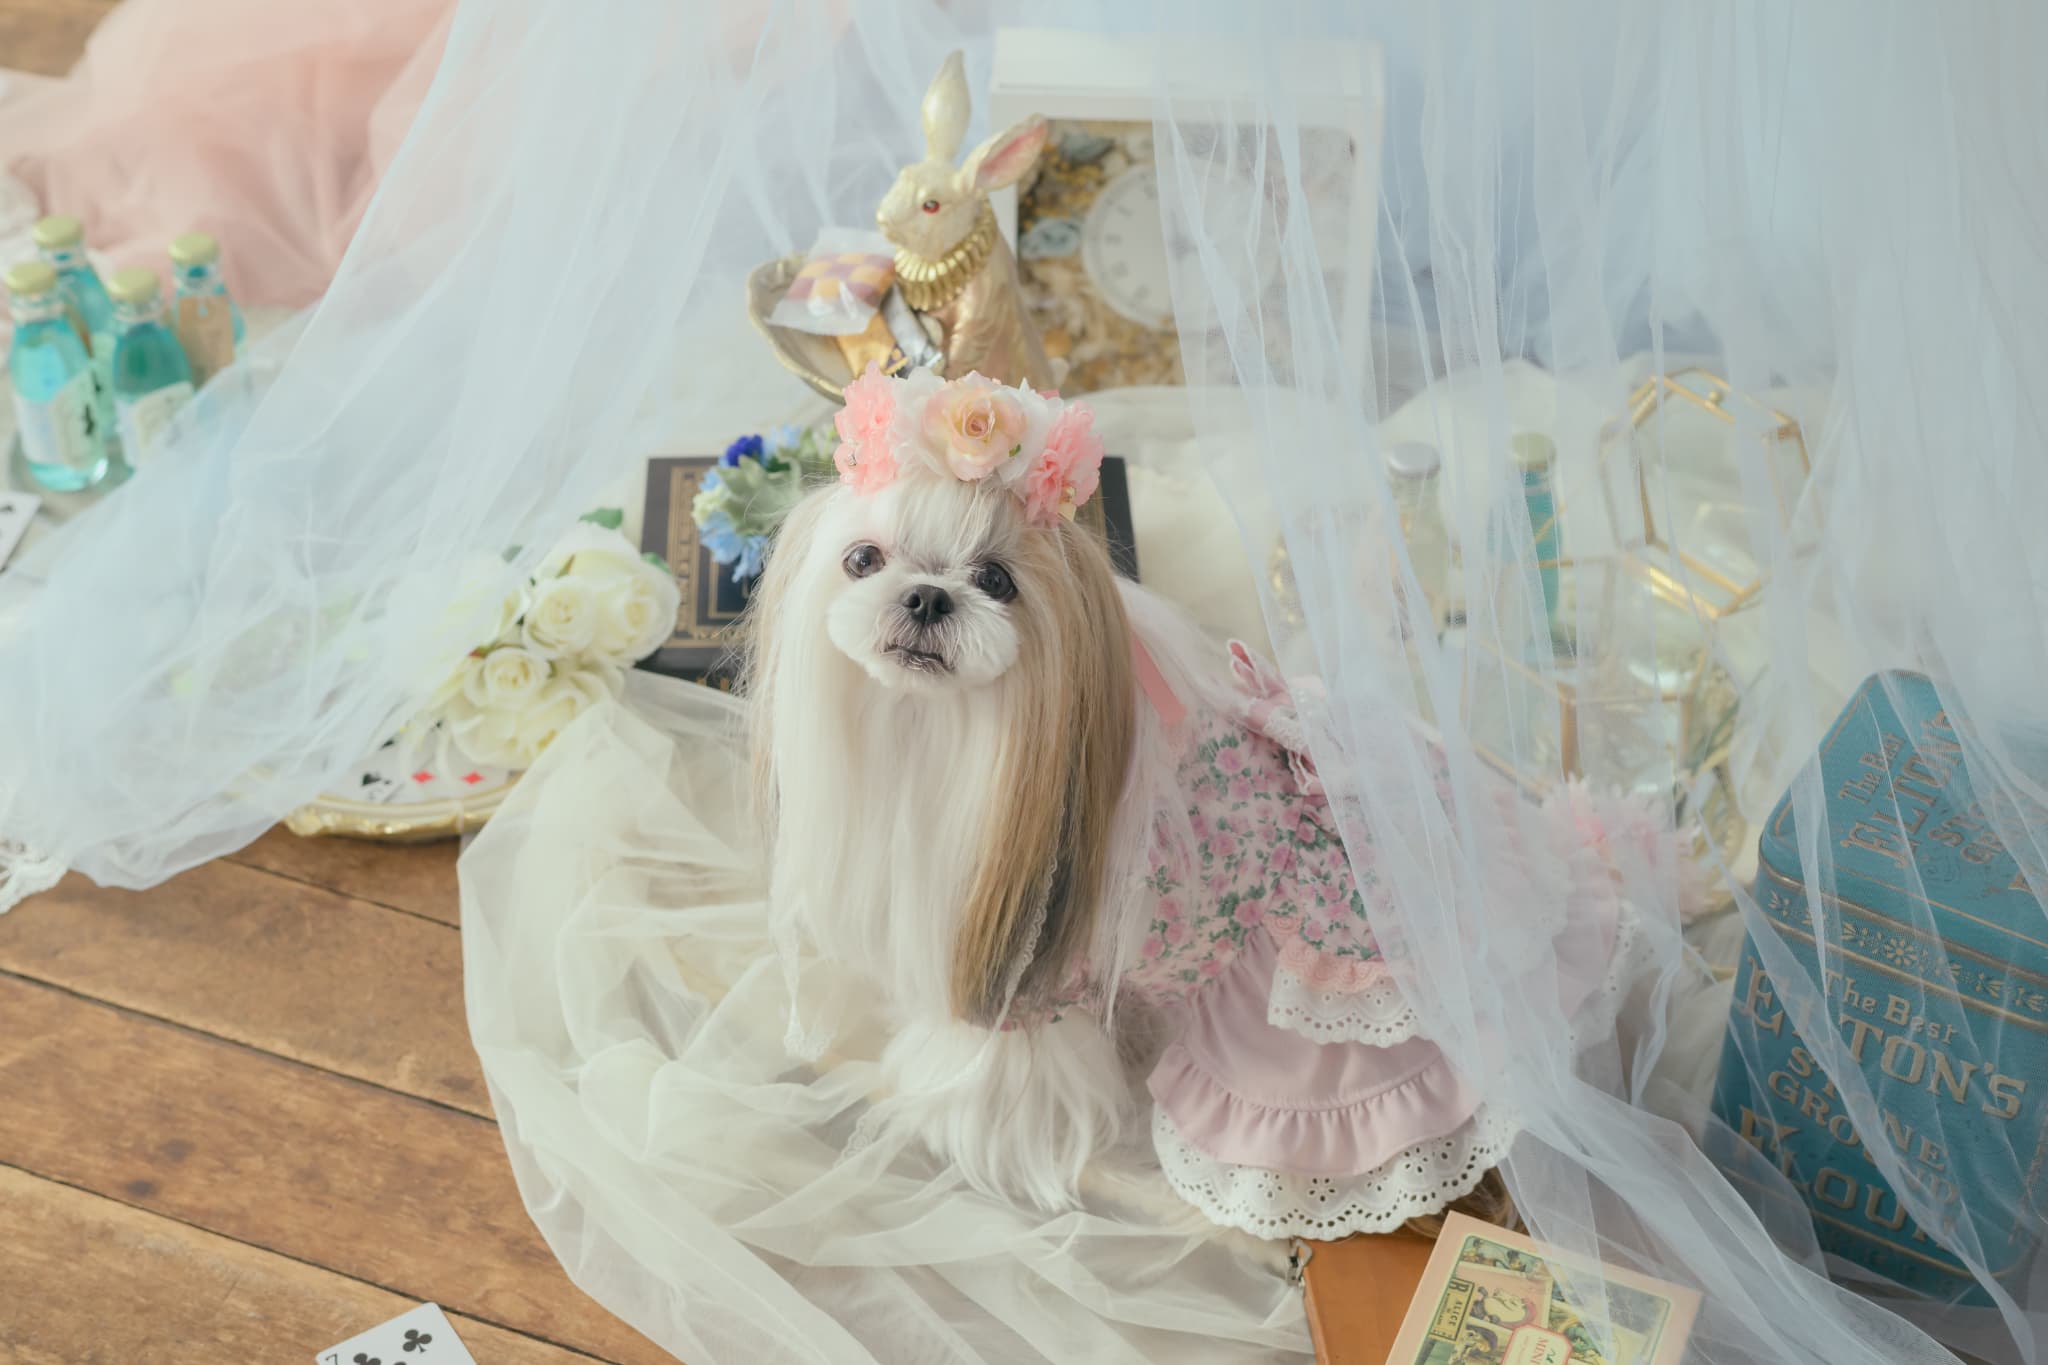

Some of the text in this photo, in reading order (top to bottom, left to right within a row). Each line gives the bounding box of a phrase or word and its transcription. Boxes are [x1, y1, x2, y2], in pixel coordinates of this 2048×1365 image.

[1839, 708, 1965, 869] ELTON
[1824, 967, 1959, 1045] The Best
[1767, 1070, 1961, 1205] GROND
